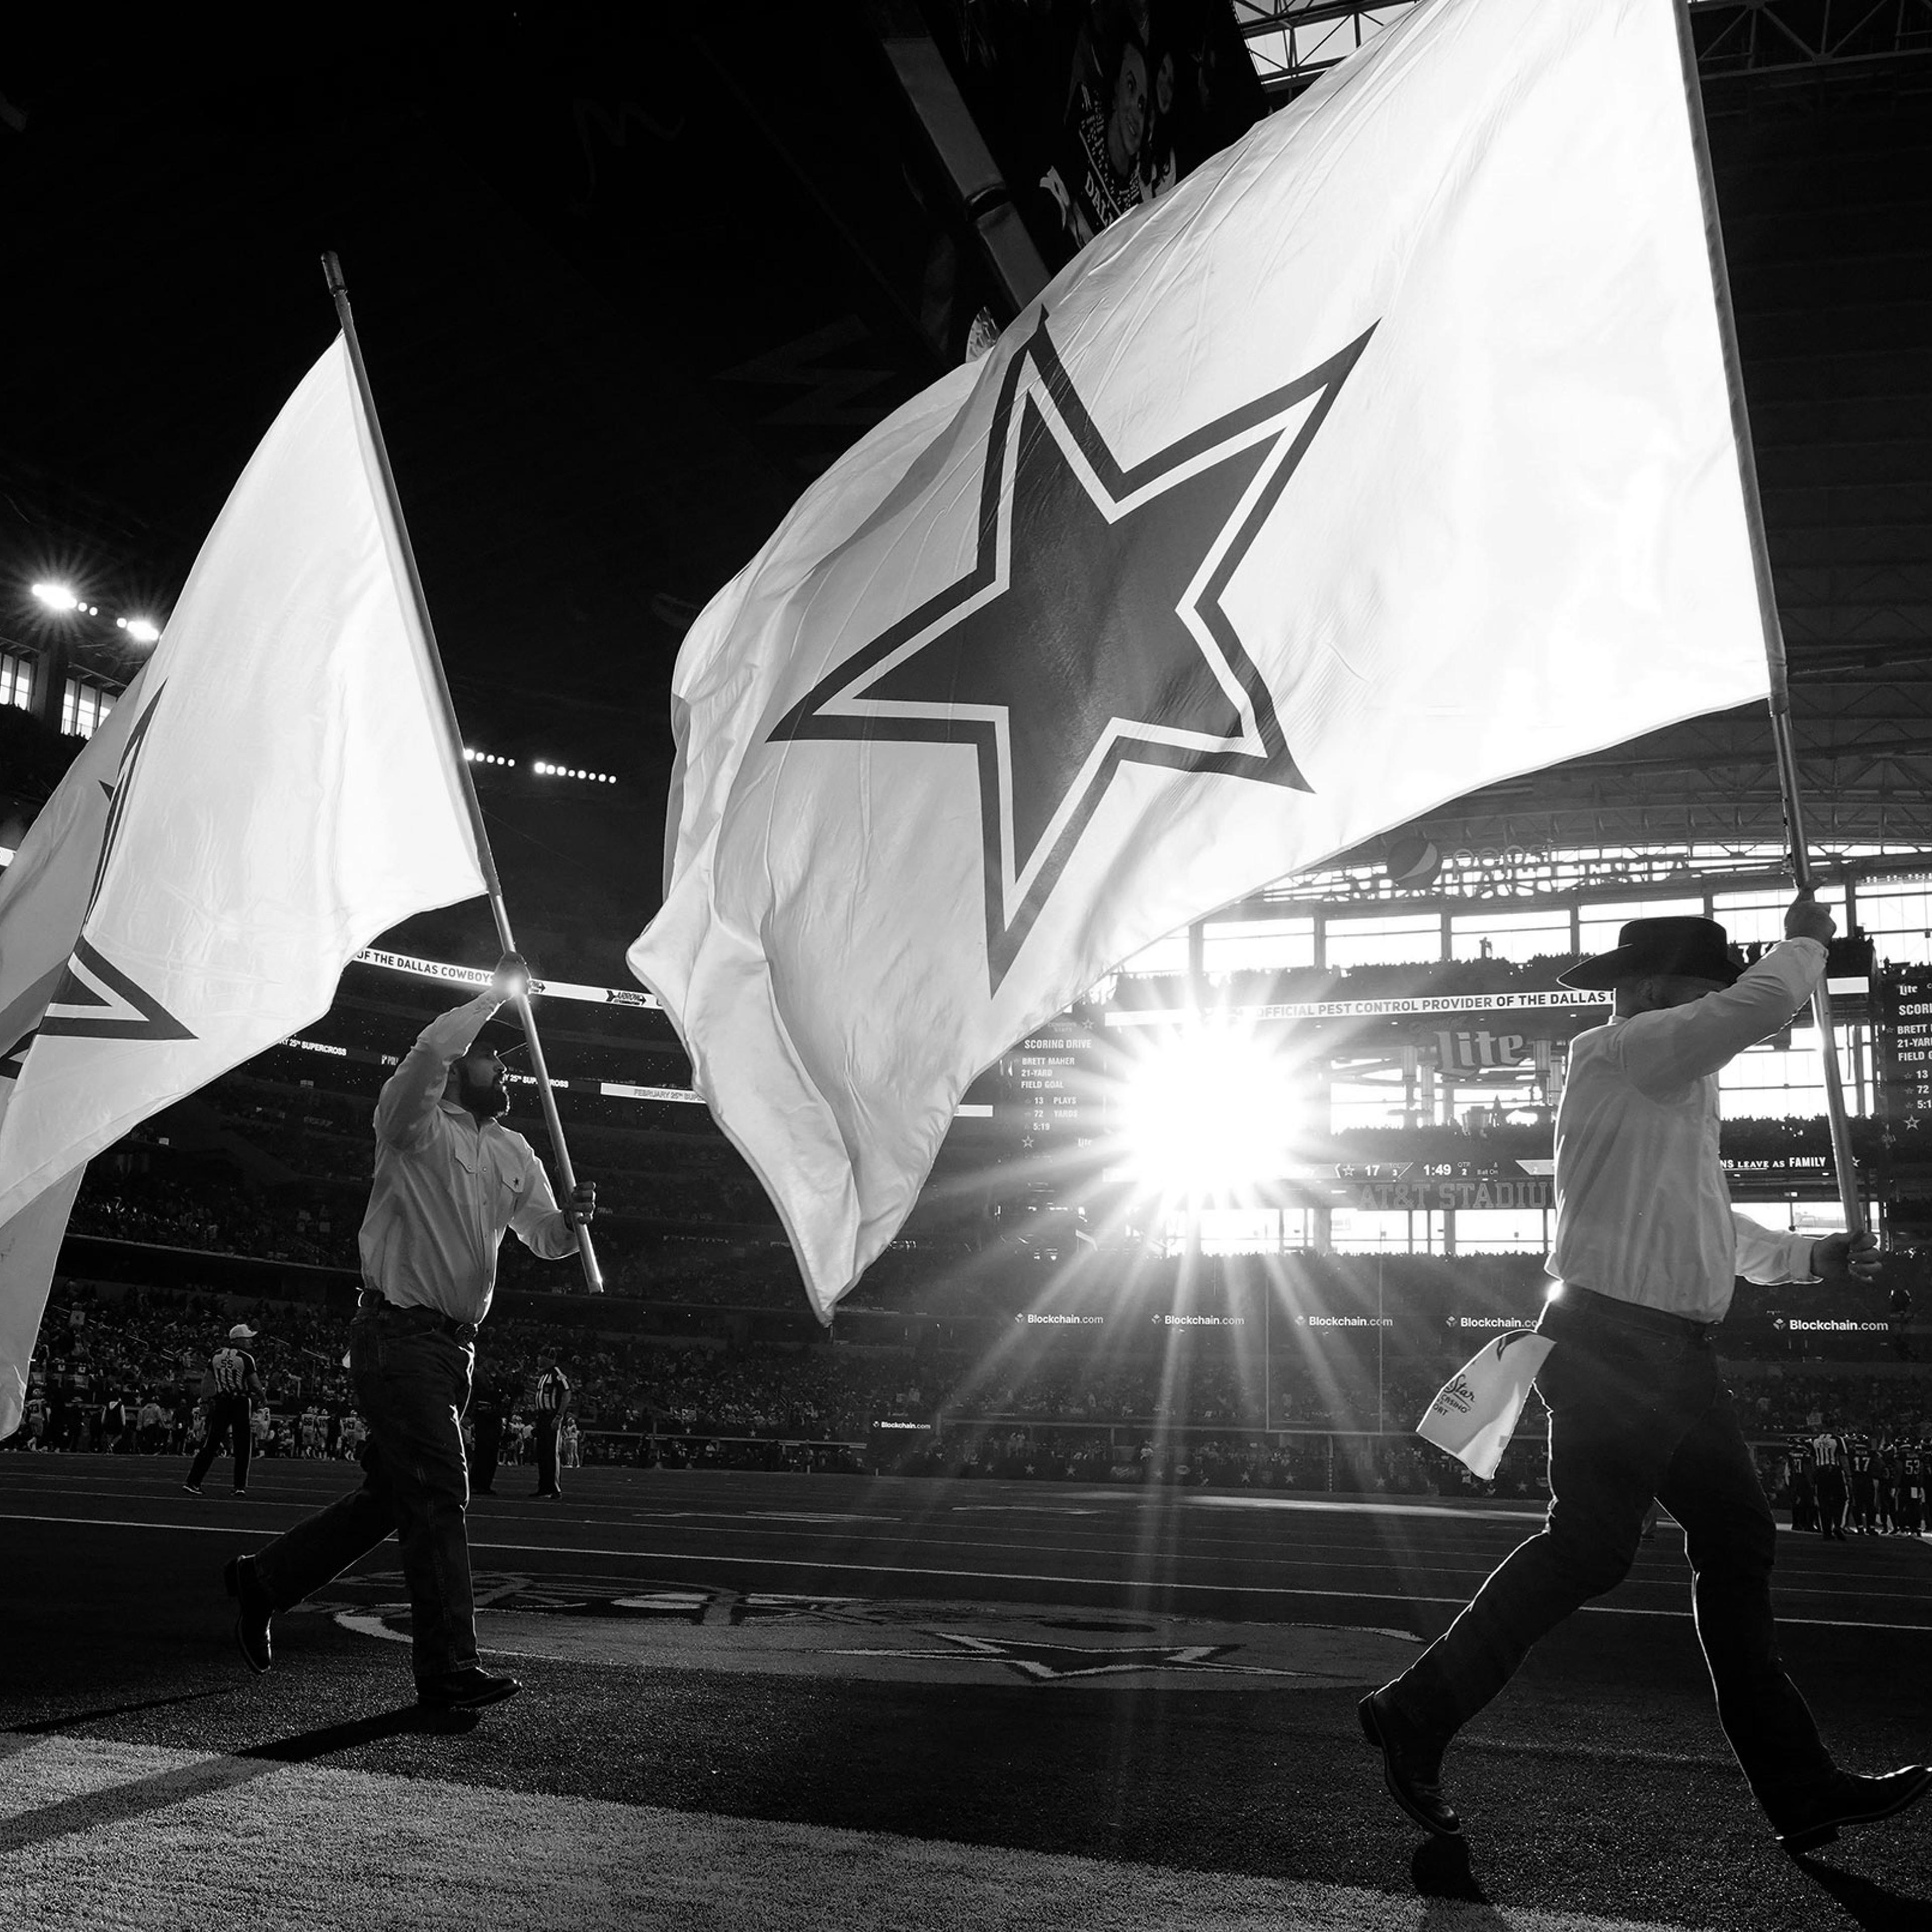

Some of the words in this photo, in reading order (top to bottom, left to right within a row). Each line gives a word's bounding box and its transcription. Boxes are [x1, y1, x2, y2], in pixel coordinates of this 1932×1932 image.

[373, 952, 394, 965] THE
[397, 958, 438, 975] DALLAS
[1899, 986, 1918, 996] Lite
[1257, 1006, 1315, 1018] OFFICIAL
[1318, 1003, 1352, 1015] PEST
[1355, 999, 1419, 1014] CONTROL
[1422, 997, 1492, 1010] PROVIDER
[1496, 995, 1515, 1007] OF
[1518, 994, 1546, 1005] THE
[1550, 991, 1606, 1005] DALLAS
[1897, 1024, 1927, 1034] BRETT
[302, 1040, 347, 1056] SUPERCROSS
[1024, 1039, 1064, 1049] SCORING
[1066, 1039, 1091, 1049] DRIVE
[1434, 1031, 1523, 1077] Lite
[1898, 1051, 1925, 1062] FIELD
[1022, 1057, 1046, 1066] BRETT
[1048, 1057, 1075, 1066] MAHER
[1021, 1069, 1053, 1078] 21-YARD
[1916, 1070, 1928, 1079] 13
[1021, 1080, 1042, 1089] FIELD
[1044, 1080, 1064, 1089] GOAL
[1916, 1085, 1929, 1094] 72
[1034, 1096, 1043, 1104] 13
[1053, 1096, 1077, 1105] PLAYS
[1034, 1109, 1043, 1118] 72
[1054, 1109, 1078, 1118] YARDS
[1032, 1122, 1051, 1131] 5:19
[1789, 1157, 1826, 1168] FAMILY
[1365, 1165, 1380, 1176] 17
[1423, 1164, 1452, 1176] 1:49
[1358, 1183, 1431, 1210] AT&T
[1439, 1182, 1555, 1209] STADIU
[1027, 1314, 1103, 1324] Blockchain.com
[1165, 1315, 1245, 1325] Blockchain.com
[1309, 1316, 1393, 1327] Blockchain.com
[1789, 1319, 1889, 1331] Blockchain.com
[1443, 1374, 1475, 1402] Star
[1441, 1394, 1468, 1413] CASINO
[881, 1421, 931, 1429] Blockchain.com
[1853, 1457, 1871, 1472] 17
[1905, 1459, 1920, 1475] 53
